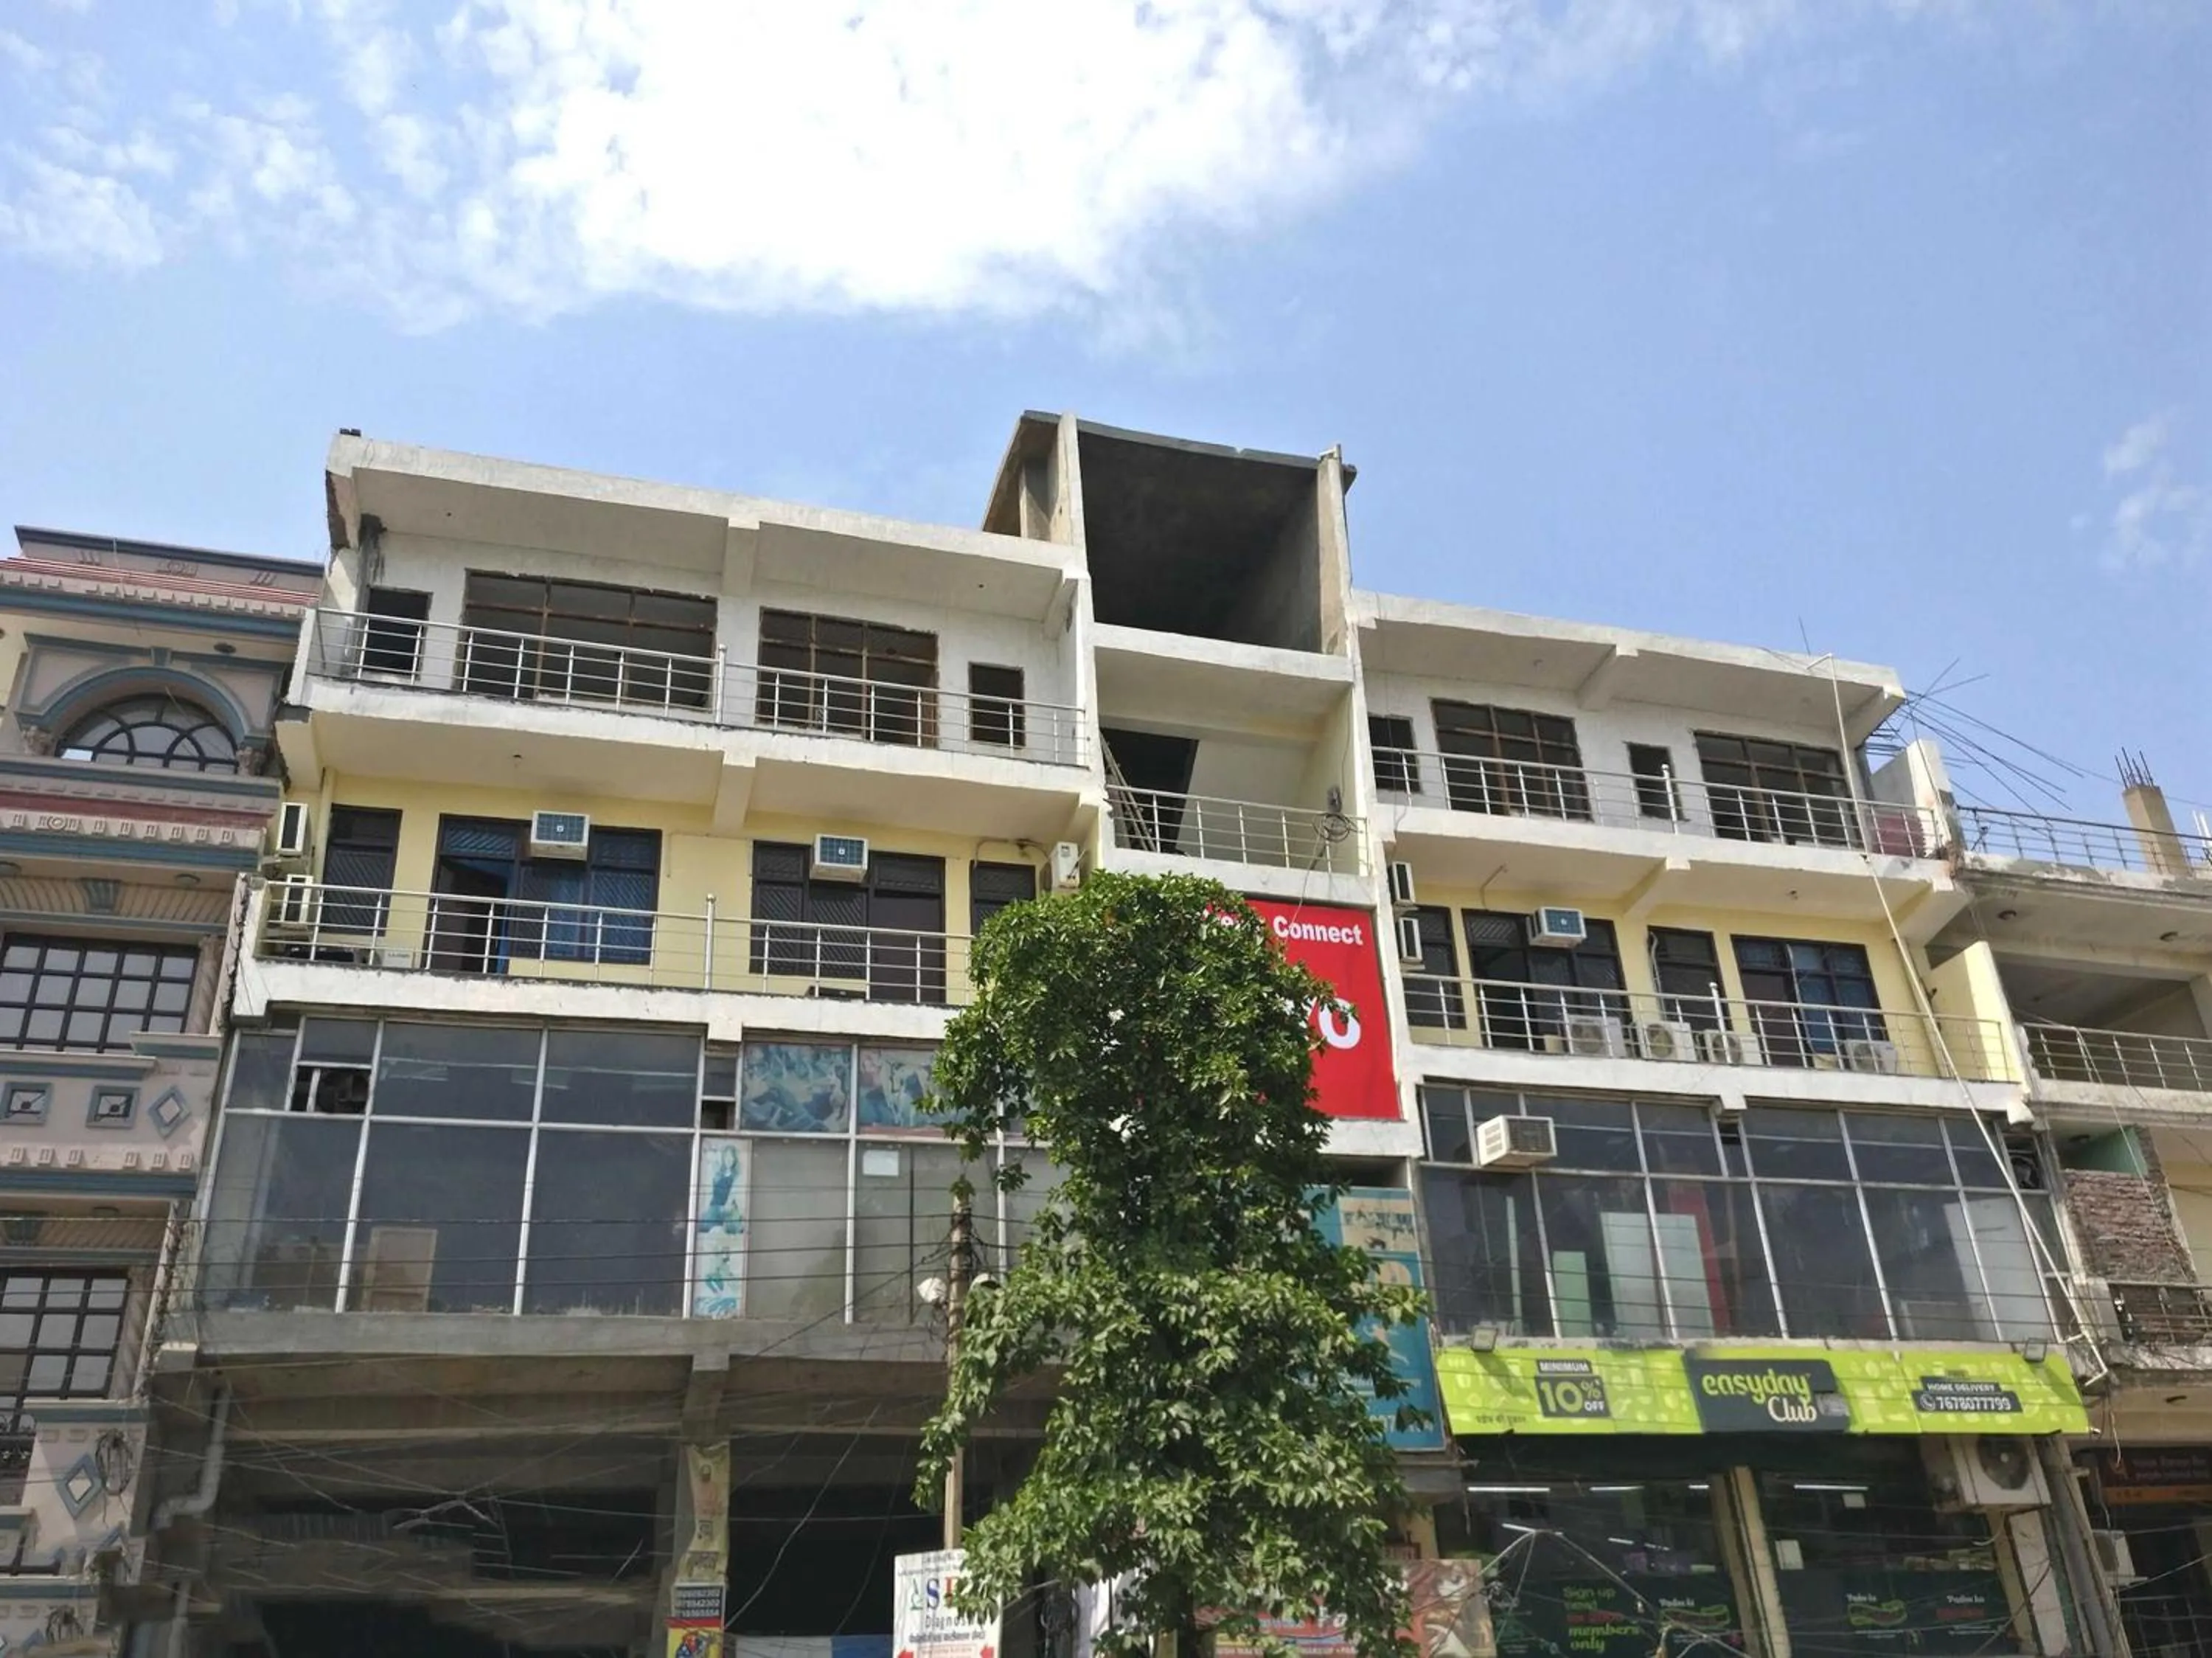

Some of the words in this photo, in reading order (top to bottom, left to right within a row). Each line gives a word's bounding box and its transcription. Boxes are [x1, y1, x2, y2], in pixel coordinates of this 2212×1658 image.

[1273, 915, 1363, 946] Connect
[1539, 1361, 1590, 1372] MINIMUM
[1702, 1367, 1812, 1406] easyday
[1927, 1382, 1953, 1392] HOME
[1954, 1383, 1995, 1392] DELIVERY
[1584, 1401, 1604, 1412] OFF
[1767, 1395, 1818, 1422] Club
[1568, 1622, 1640, 1637] members
[1570, 1635, 1605, 1654] only
